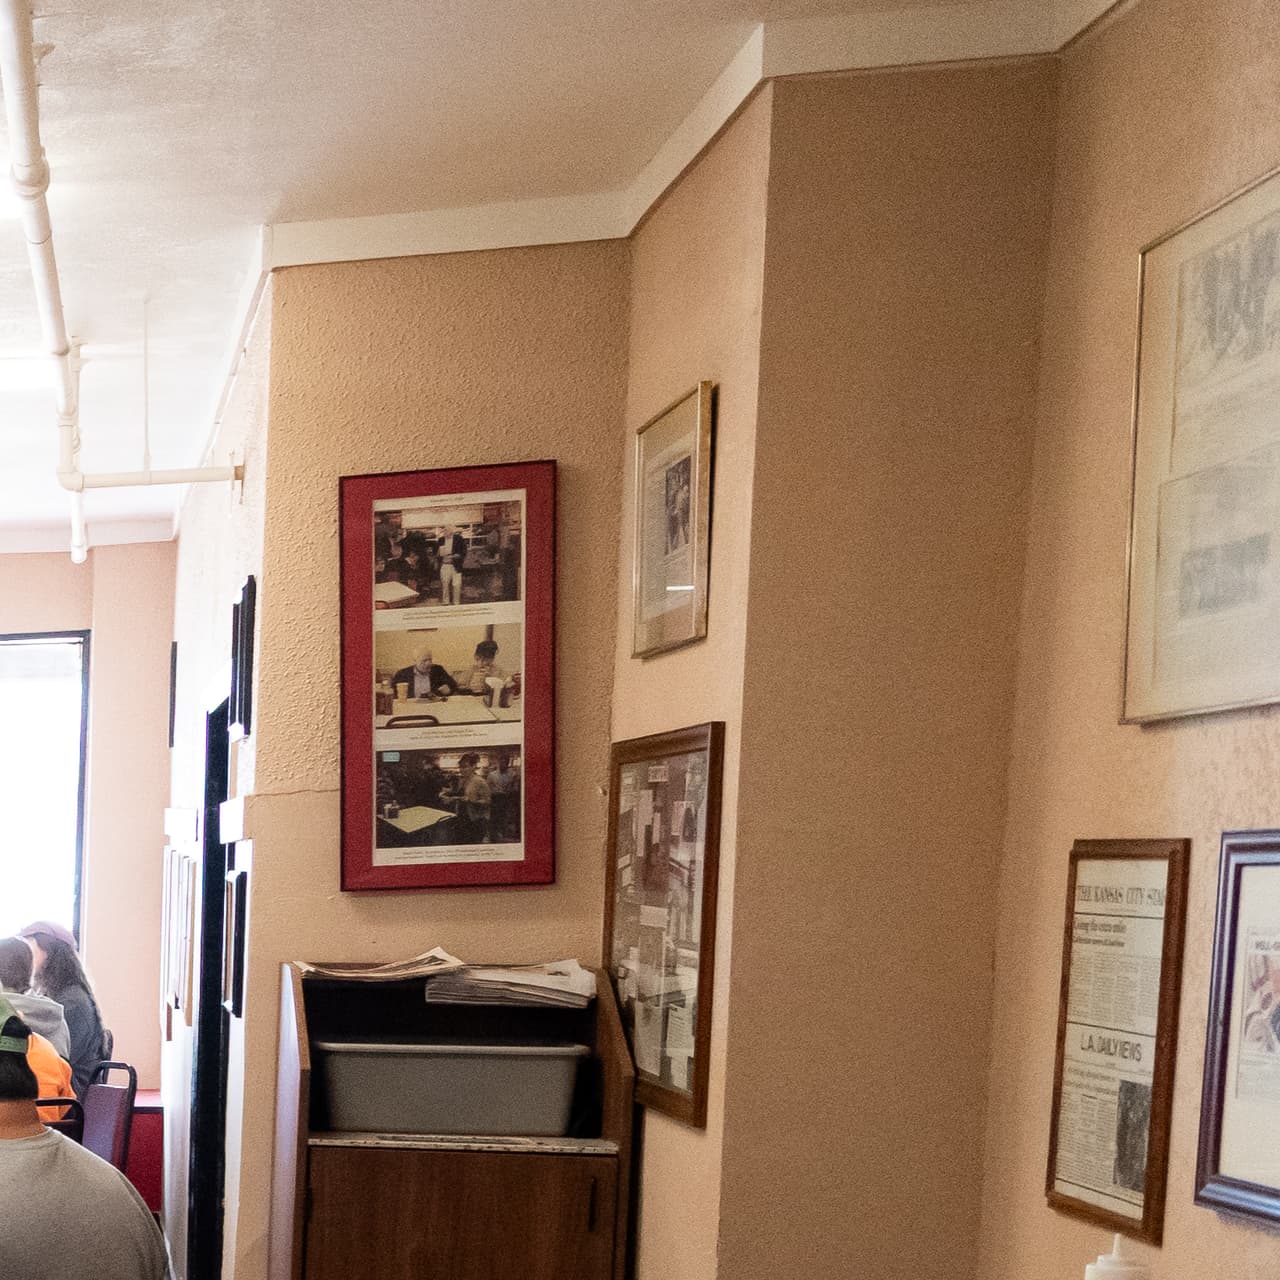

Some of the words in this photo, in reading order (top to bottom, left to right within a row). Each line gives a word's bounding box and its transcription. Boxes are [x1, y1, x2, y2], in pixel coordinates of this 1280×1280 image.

[1076, 884, 1093, 902] THE
[1093, 885, 1124, 904] KANSAS
[1126, 886, 1146, 905] CITY
[1146, 887, 1165, 906] STA
